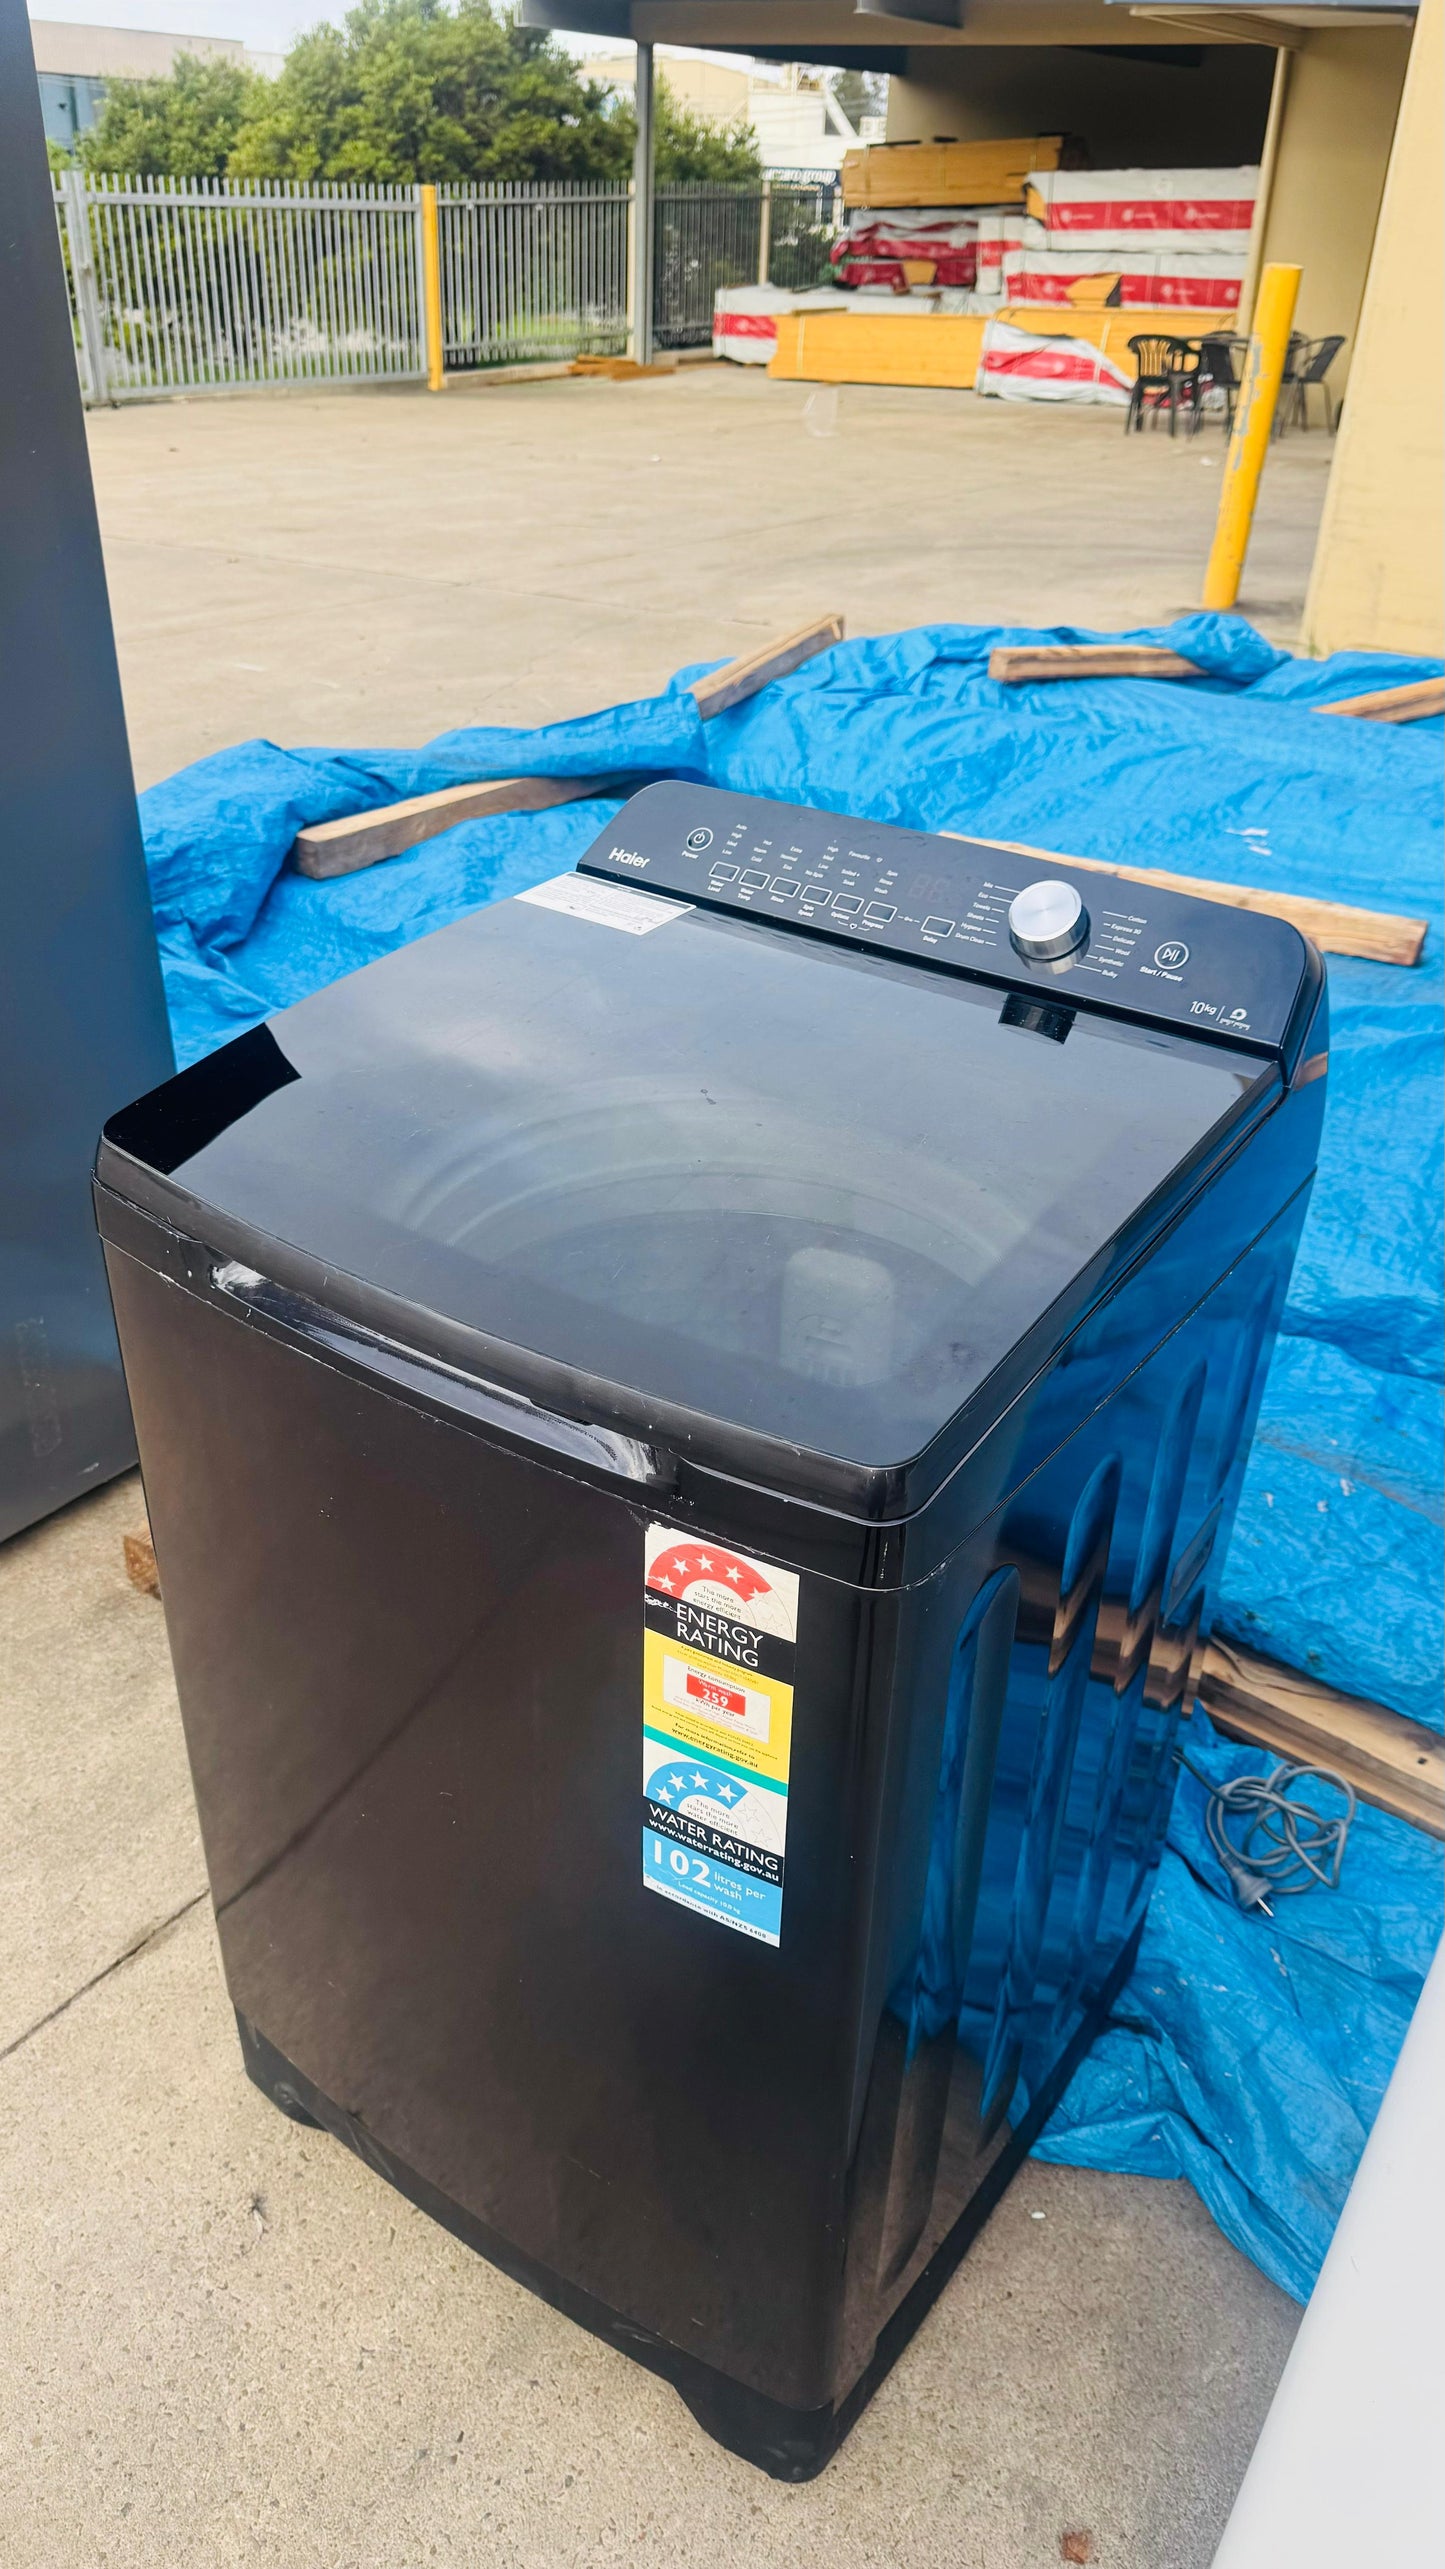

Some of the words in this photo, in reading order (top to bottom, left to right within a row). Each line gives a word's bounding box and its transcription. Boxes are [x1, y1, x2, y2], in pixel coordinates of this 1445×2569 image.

[608, 847, 650, 869] Haier
[681, 850, 699, 859] Power
[1139, 966, 1156, 976] Start
[1160, 971, 1184, 982] Pause
[1189, 1001, 1217, 1016] 10kg
[692, 1598, 714, 1610] energy
[694, 1591, 710, 1601] stars
[711, 1597, 722, 1606] the
[723, 1602, 742, 1614] more
[702, 1585, 715, 1596] The
[716, 1592, 734, 1603] more
[676, 1603, 763, 1649] ENERGY
[677, 1621, 759, 1667] RATING
[687, 1665, 707, 1678] Energy
[707, 1675, 746, 1693] consumption
[698, 1678, 719, 1693] Warm
[718, 1688, 733, 1698] wash
[702, 1688, 729, 1707] 259
[711, 1704, 721, 1712] per
[722, 1708, 735, 1718] year
[687, 1803, 703, 1814] stars
[706, 1811, 718, 1820] the
[719, 1817, 739, 1829] more
[695, 1798, 709, 1809] The
[711, 1807, 730, 1819] more
[686, 1809, 707, 1822] water
[709, 1820, 738, 1836] efficient
[649, 1803, 707, 1841] WATER
[712, 1833, 778, 1871] RATING
[649, 1819, 779, 1882] www.waterrating.gov.au
[654, 1839, 711, 1888] 102
[713, 1883, 742, 1901] wash
[714, 1871, 743, 1892] litres
[745, 1886, 766, 1900] per
[693, 1889, 718, 1905] capacity
[703, 1908, 719, 1918] with
